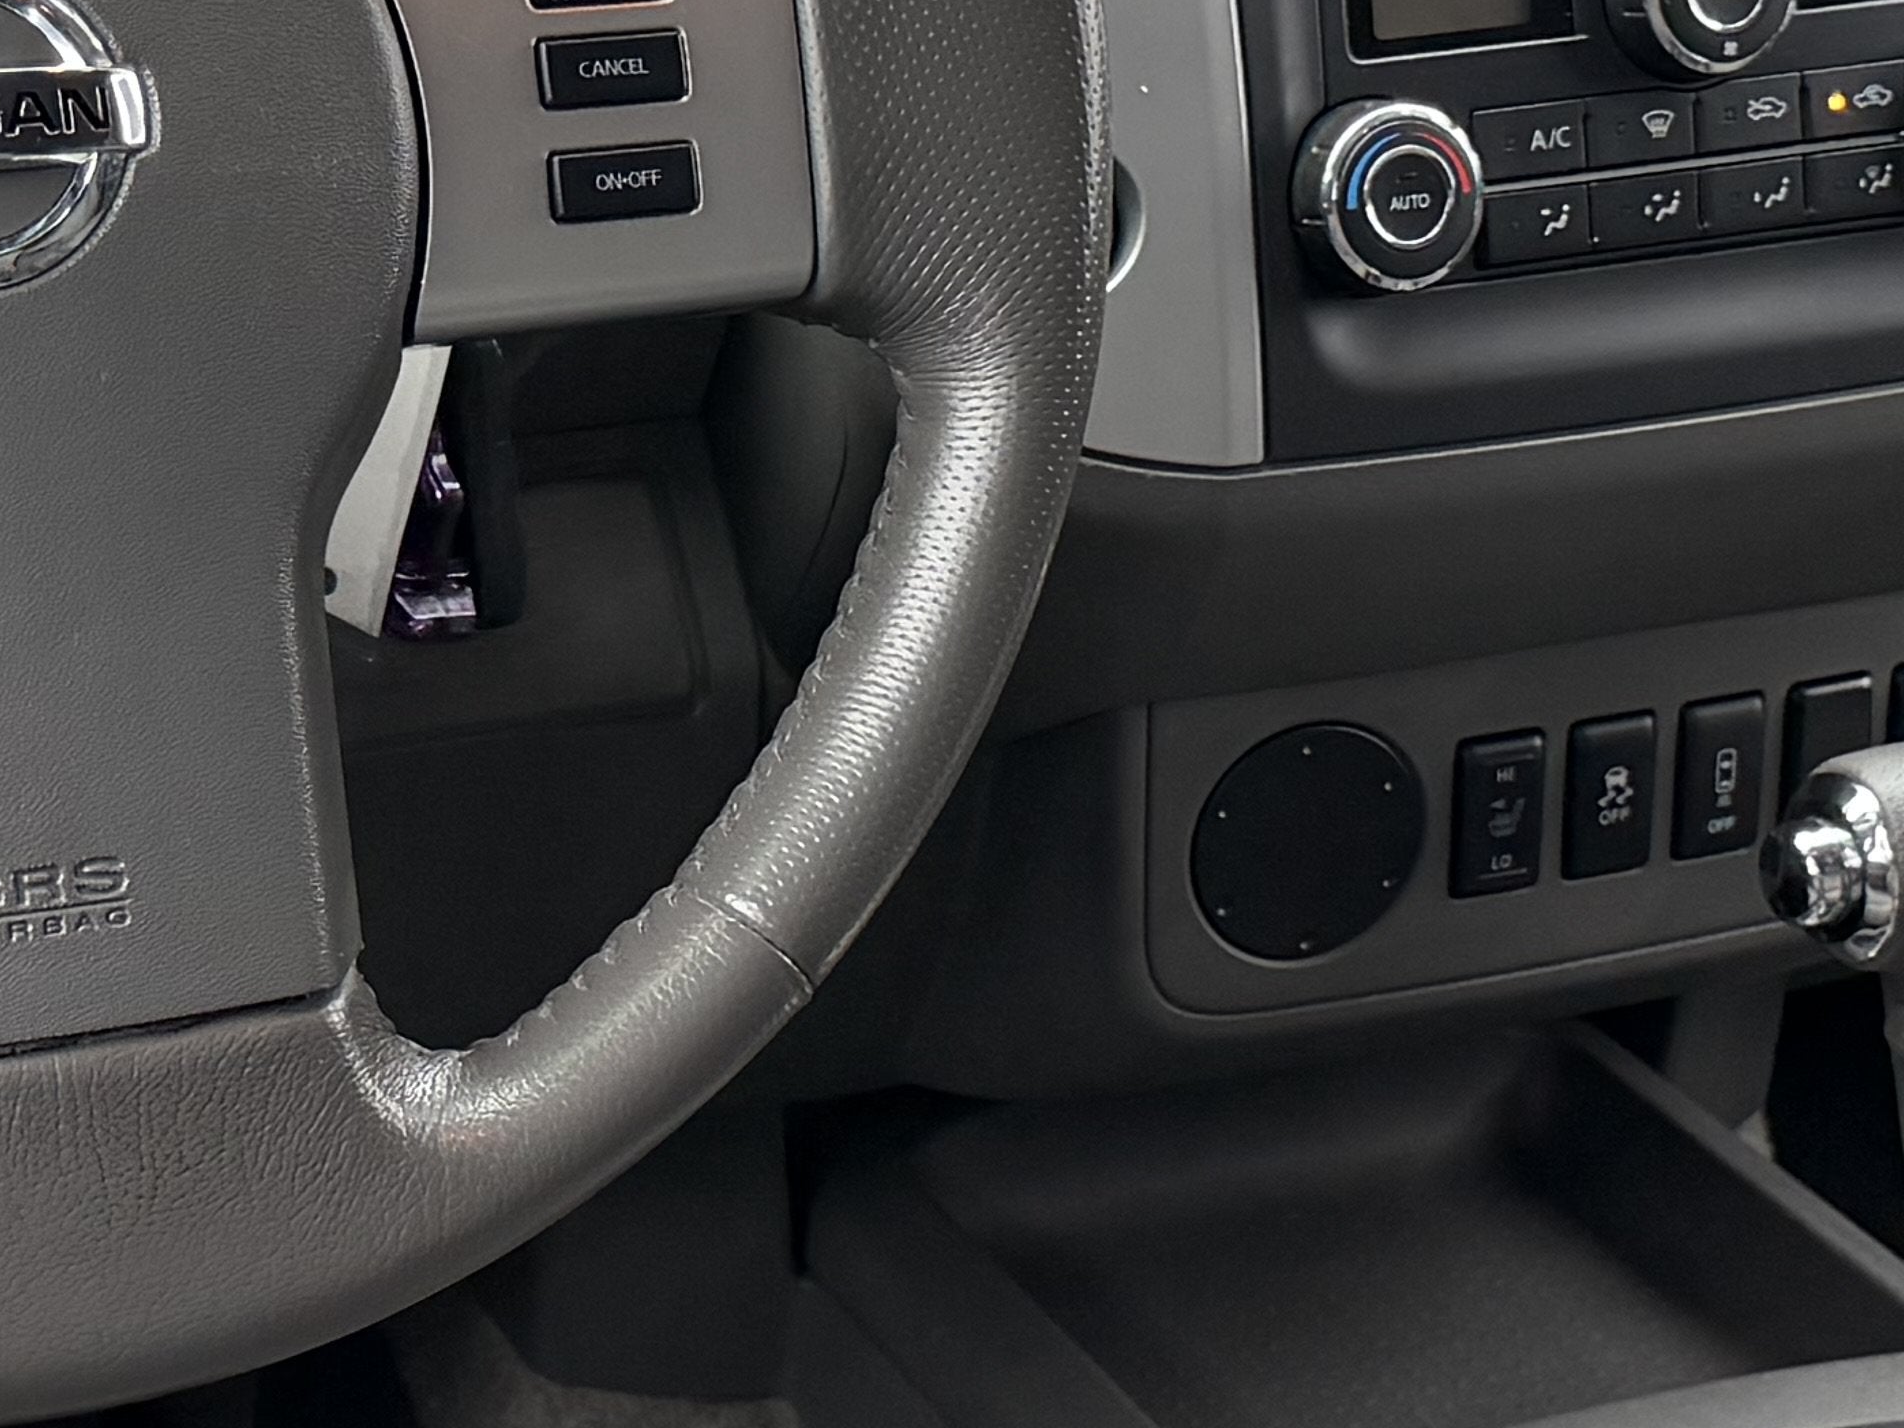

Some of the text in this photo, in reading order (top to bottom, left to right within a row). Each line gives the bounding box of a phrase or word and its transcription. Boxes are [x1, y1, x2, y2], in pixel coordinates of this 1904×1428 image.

[578, 57, 650, 79] CANCEL
[1529, 126, 1572, 153] A/C
[1388, 192, 1431, 213] AUTO
[1598, 808, 1632, 826] OFF
[1706, 814, 1737, 834] OFF
